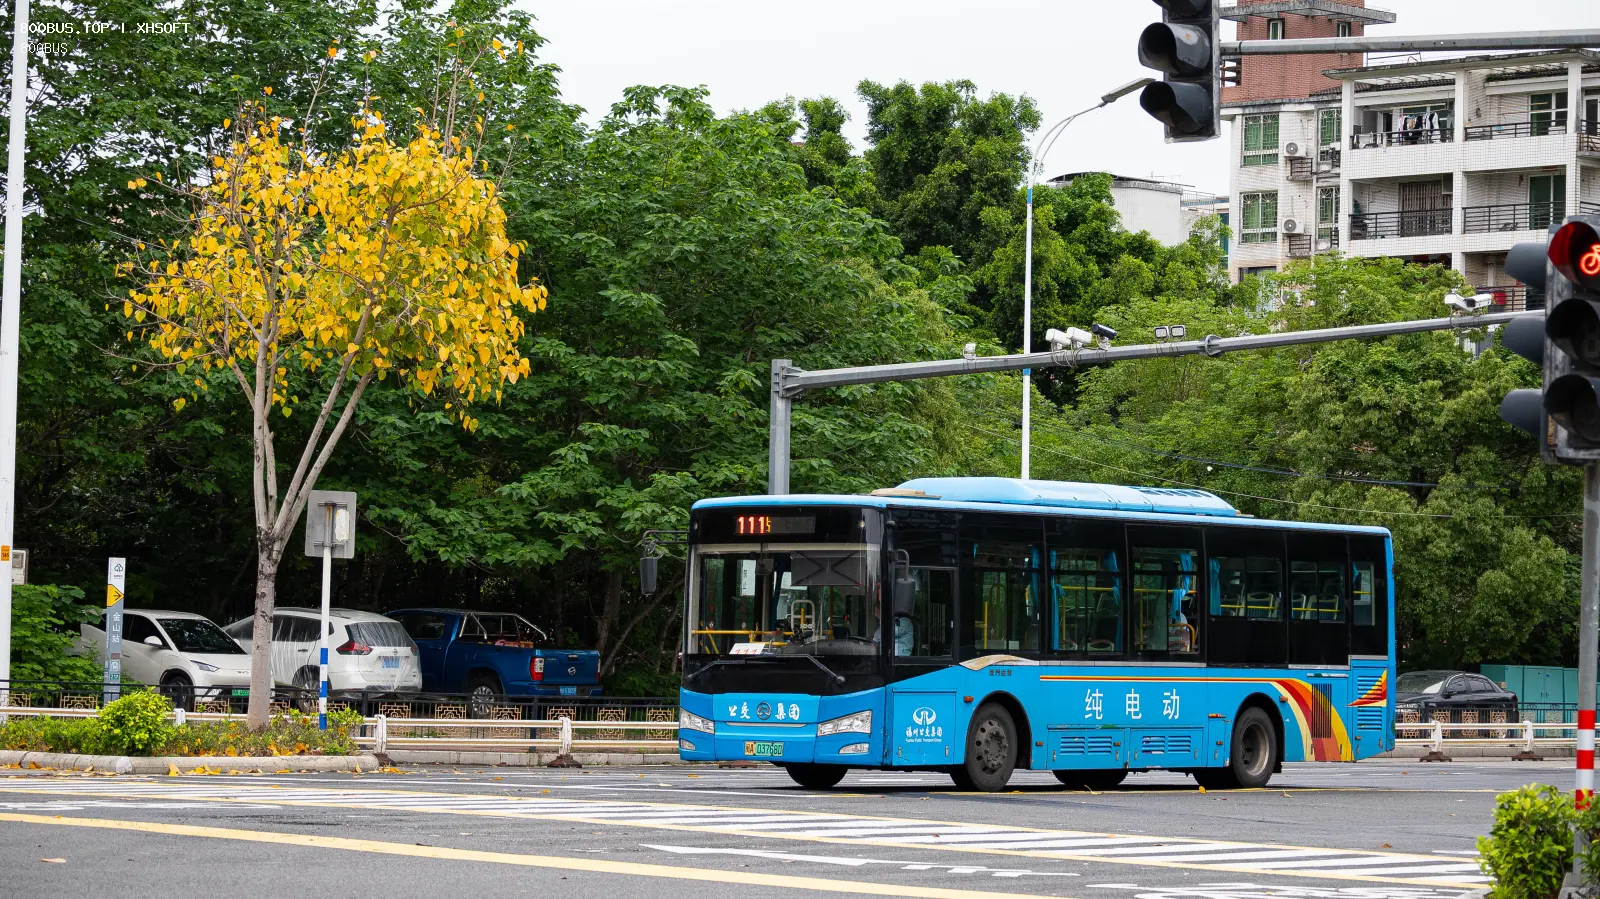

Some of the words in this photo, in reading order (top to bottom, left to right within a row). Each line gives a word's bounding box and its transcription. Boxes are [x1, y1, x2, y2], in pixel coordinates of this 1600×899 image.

[112, 612, 121, 643] 金山站
[1084, 688, 1180, 720] 纯电动
